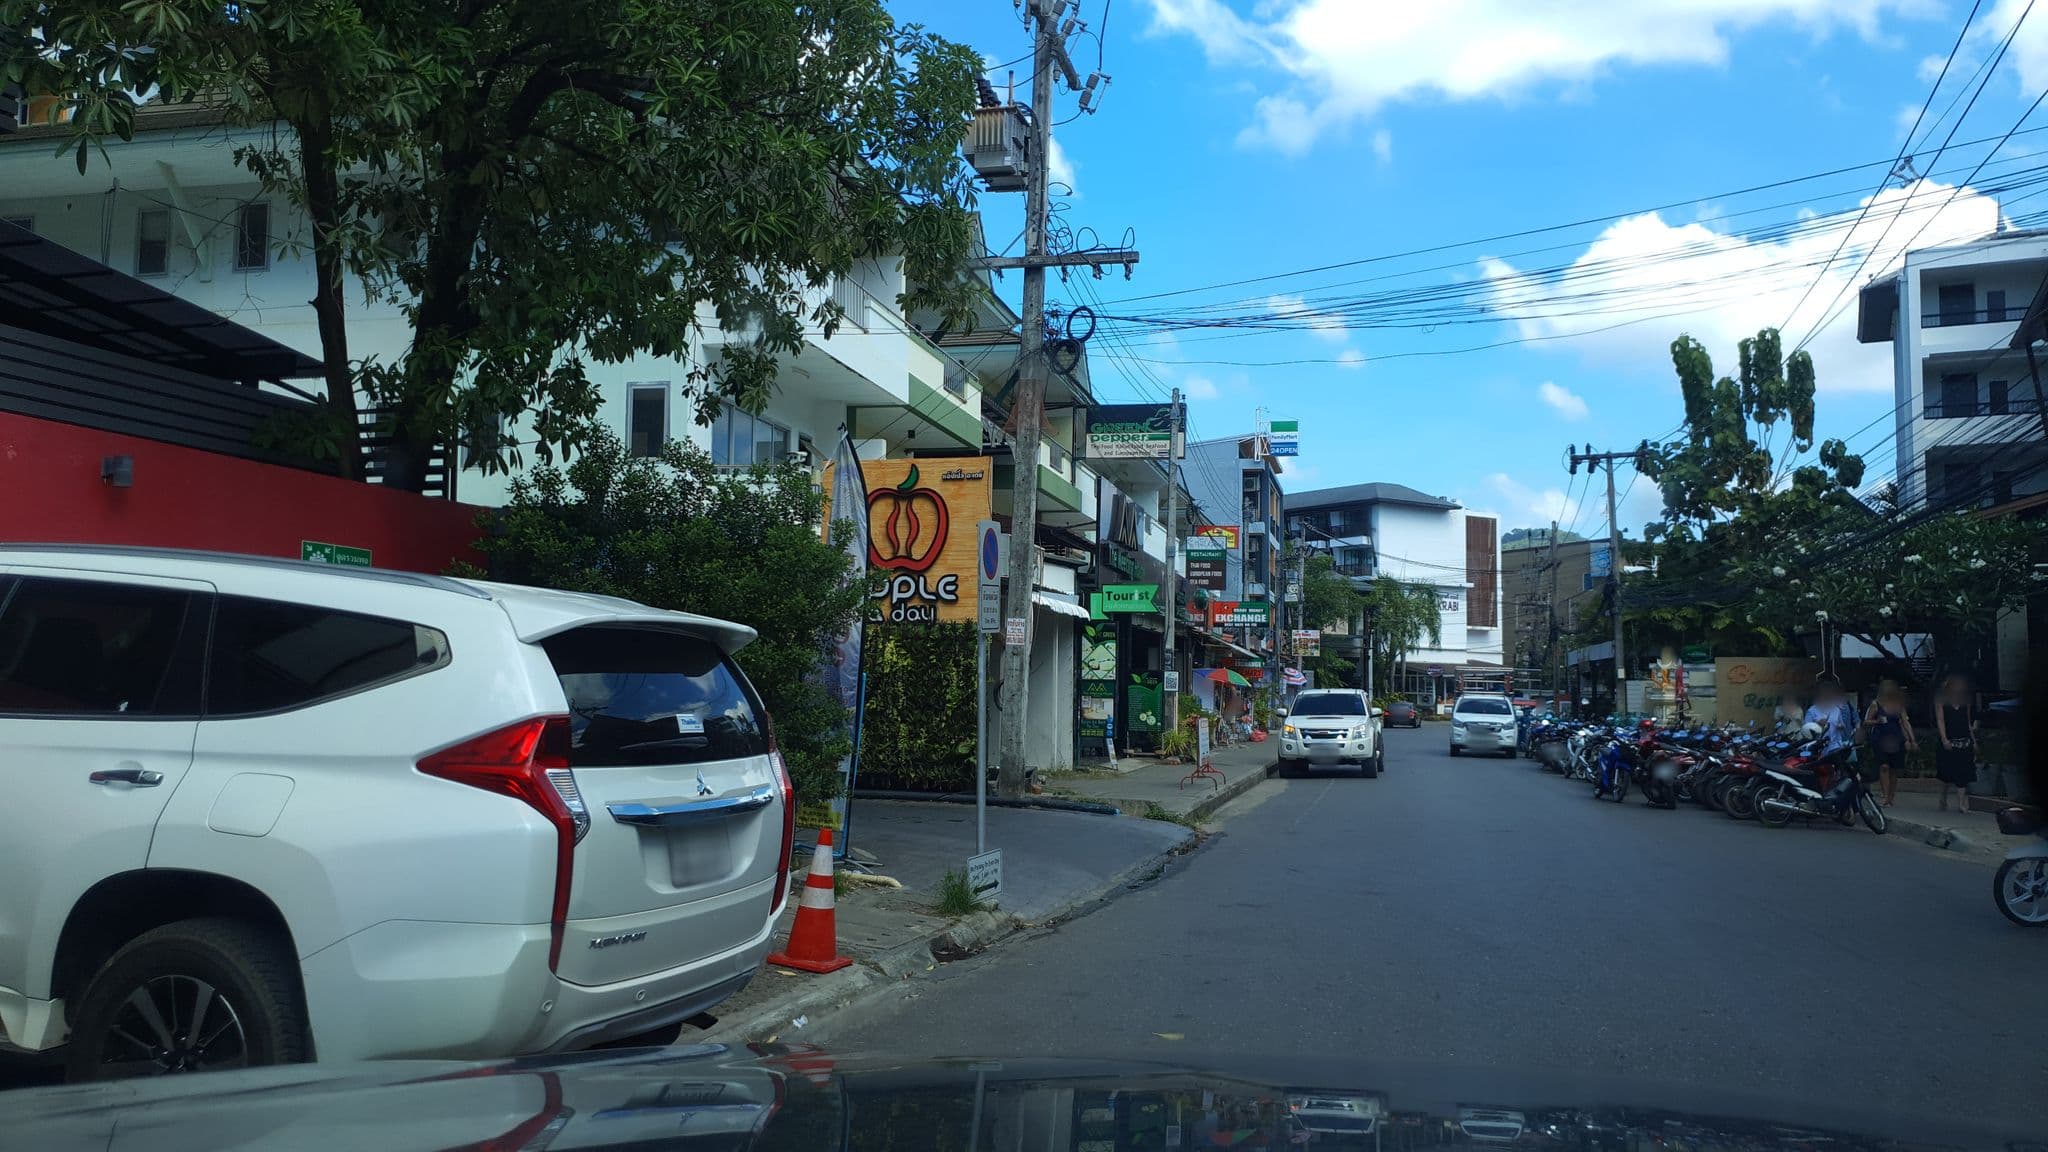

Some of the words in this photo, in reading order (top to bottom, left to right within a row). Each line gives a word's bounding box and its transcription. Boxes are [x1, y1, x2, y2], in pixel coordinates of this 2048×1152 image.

[1091, 422, 1149, 433] GREEN
[1090, 433, 1148, 443] pepper
[1105, 589, 1150, 601] Tourist
[892, 602, 934, 622] day
[1438, 601, 1459, 612] KRABI
[1215, 613, 1267, 622] EXCHANGE
